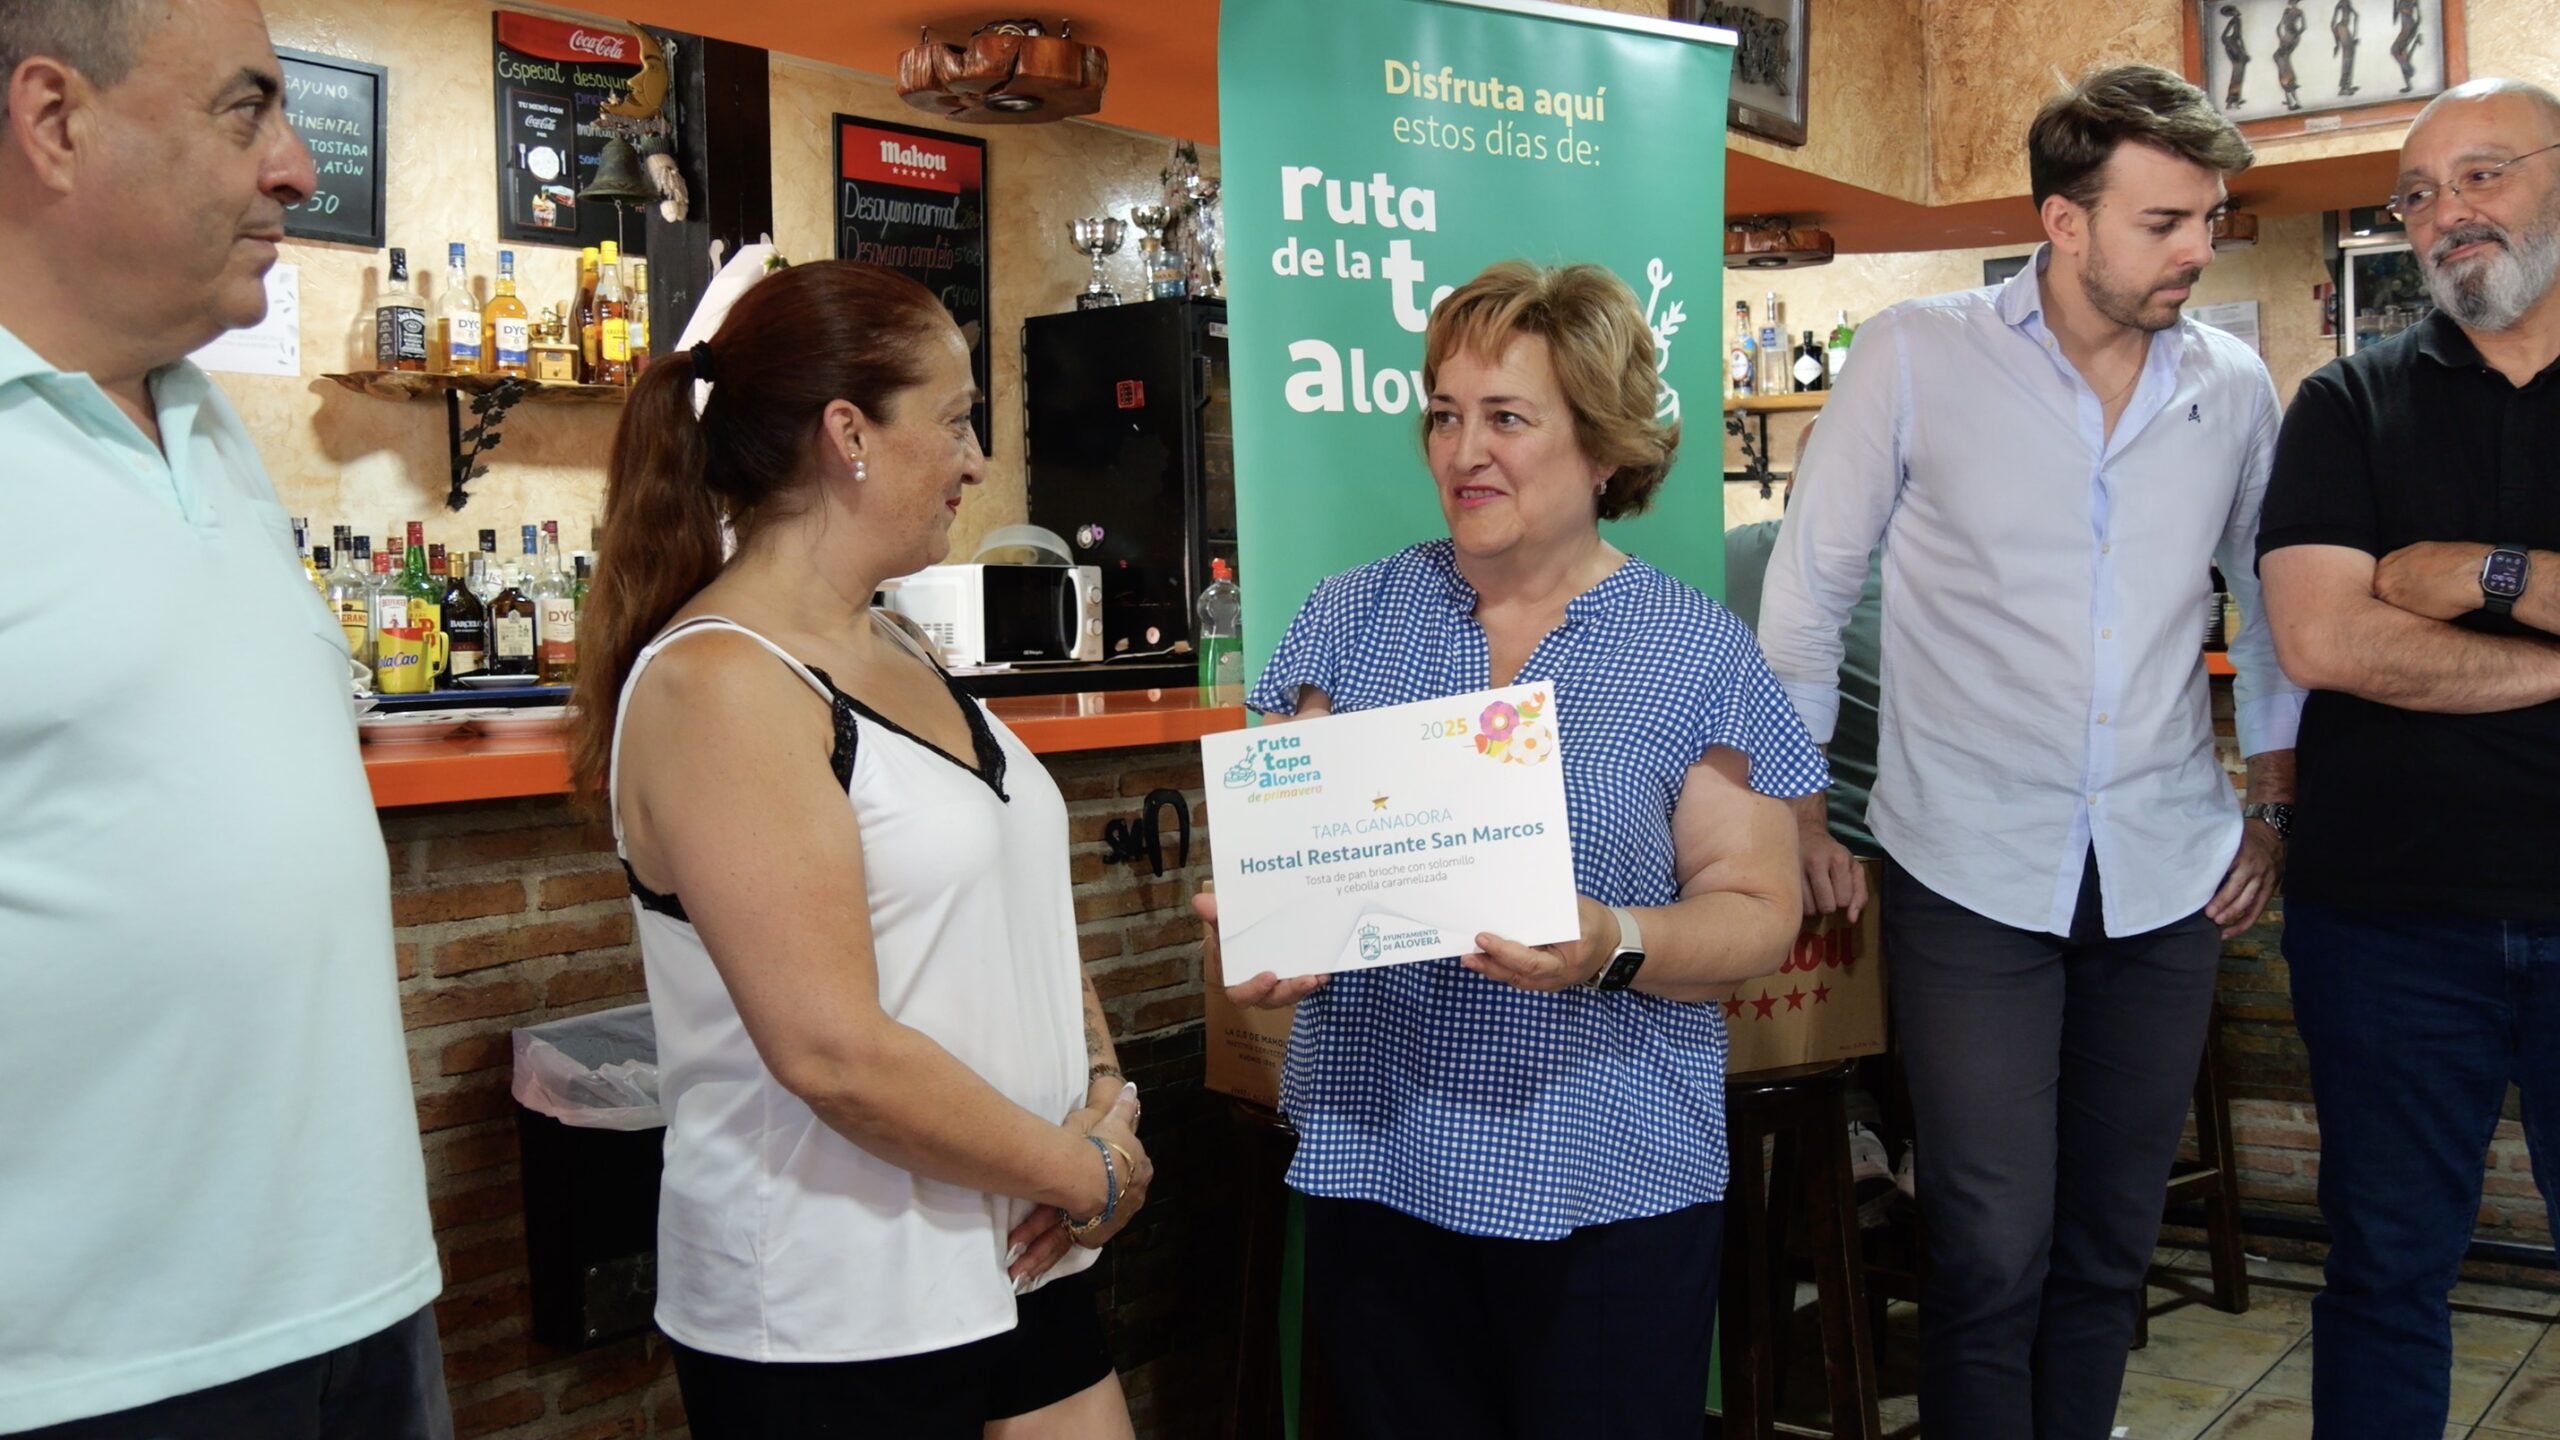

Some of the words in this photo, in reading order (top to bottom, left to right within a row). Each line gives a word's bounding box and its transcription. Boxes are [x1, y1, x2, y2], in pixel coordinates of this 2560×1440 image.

[569, 30, 626, 59] Coca-Cola
[498, 52, 565, 87] Especial
[573, 65, 633, 91] desayun
[284, 75, 348, 100] SAYUNO
[1384, 59, 1524, 112] Disfruta
[1534, 86, 1607, 127] aquí
[309, 138, 368, 157] TOSTADA
[880, 140, 947, 172] Mahou
[1393, 116, 1476, 152] estos
[1486, 120, 1548, 161] días
[1557, 129, 1600, 166] de:
[844, 182, 911, 239] Desayuno
[912, 196, 960, 230] normal
[1281, 165, 1436, 232] ruta
[1272, 237, 1324, 276] de
[1336, 240, 1371, 279] la
[1257, 736, 1301, 752] ruta
[1421, 718, 1469, 741] 2025
[1264, 752, 1311, 771] tapa
[1259, 770, 1322, 788] alovera
[1248, 792, 1261, 803] de
[1264, 785, 1322, 804] primavera
[1312, 822, 1352, 839] TAPA
[1355, 808, 1453, 834] GANADORA
[1240, 850, 1303, 875] Hostal
[1308, 836, 1426, 865] Restaurante
[1431, 831, 1467, 849] San
[1473, 822, 1544, 843] Marcos
[1306, 874, 1332, 886] Tosta
[1334, 871, 1346, 882] de
[1348, 870, 1367, 883] pan
[1369, 862, 1405, 877] brioche
[1408, 862, 1426, 873] con
[1428, 855, 1475, 871] solomillo
[1336, 886, 1342, 896] y
[1344, 879, 1380, 894] cebolla
[1382, 871, 1448, 888] caramelizada
[1382, 929, 1439, 942] AYUNTAMIENTO
[1394, 936, 1441, 950] ALOVERA
[1780, 928, 1855, 974] ou
